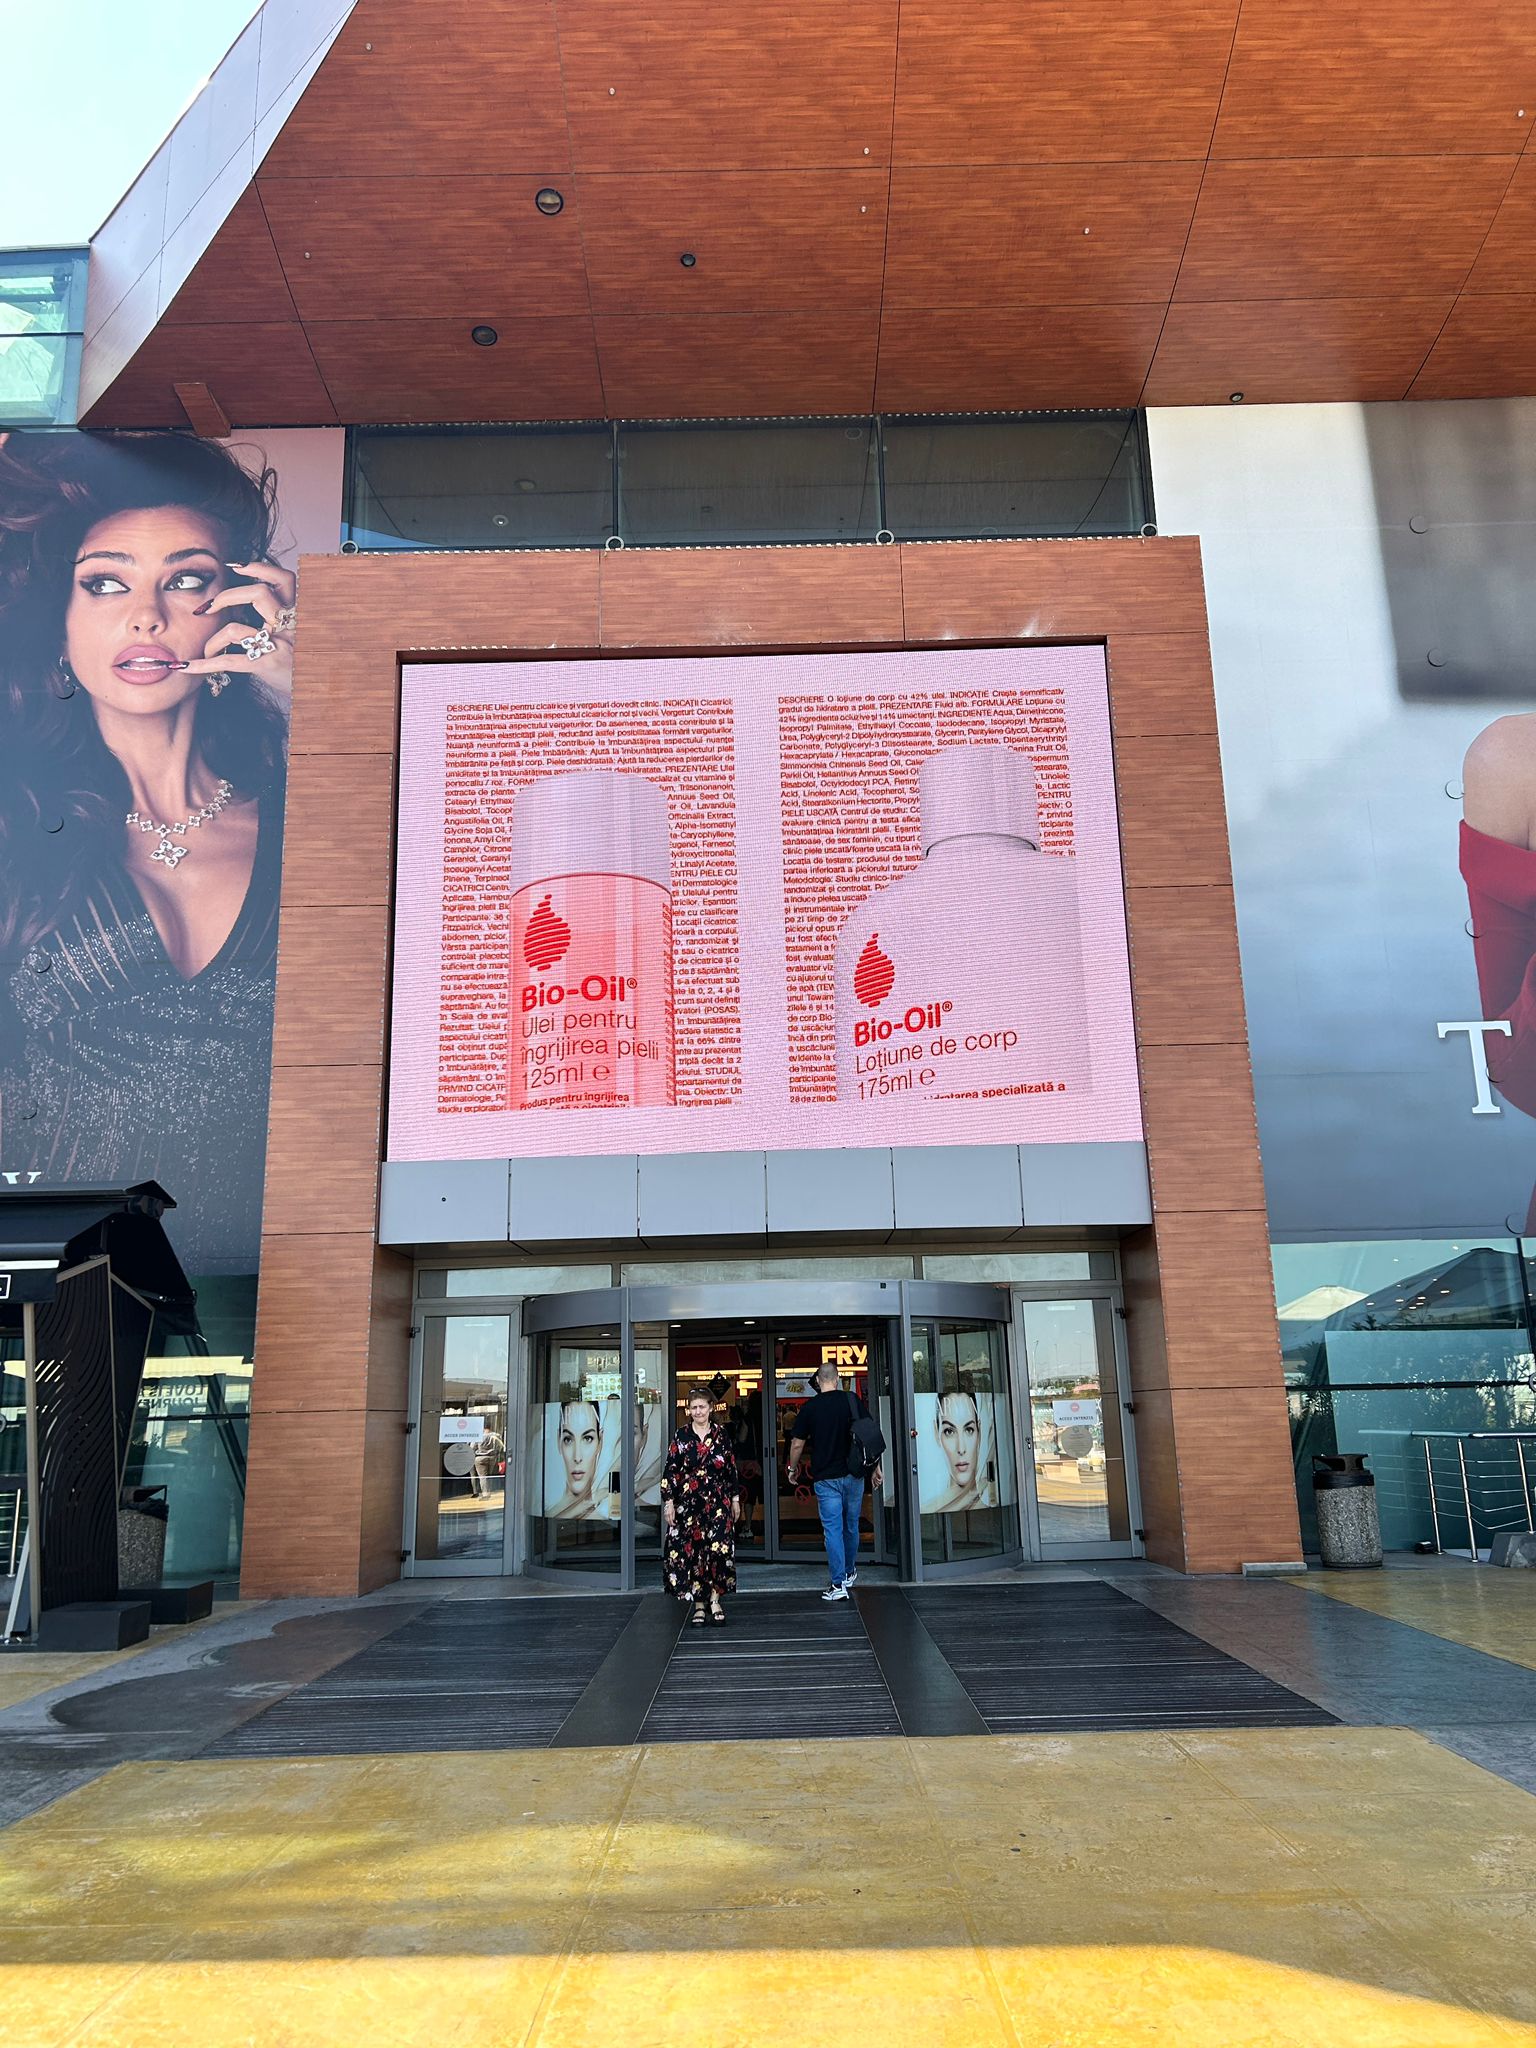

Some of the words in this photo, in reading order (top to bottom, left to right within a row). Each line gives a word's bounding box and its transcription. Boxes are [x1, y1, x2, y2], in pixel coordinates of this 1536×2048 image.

[522, 1012, 555, 1038] Ulei
[563, 1009, 637, 1033] pentru
[520, 1036, 609, 1065] îngrijirea
[617, 1036, 659, 1061] pielii
[856, 1044, 923, 1075] Loțiune
[930, 1036, 957, 1056] de
[964, 1031, 1018, 1051] corp
[522, 1062, 584, 1090] 125ml
[1437, 1020, 1513, 1114] T
[857, 1068, 913, 1100] 175ml
[981, 1081, 1054, 1098] specializată
[1057, 1083, 1066, 1091] a
[520, 1097, 547, 1110] Produs
[549, 1092, 583, 1106] pentru
[584, 1091, 630, 1102] îngrijirea
